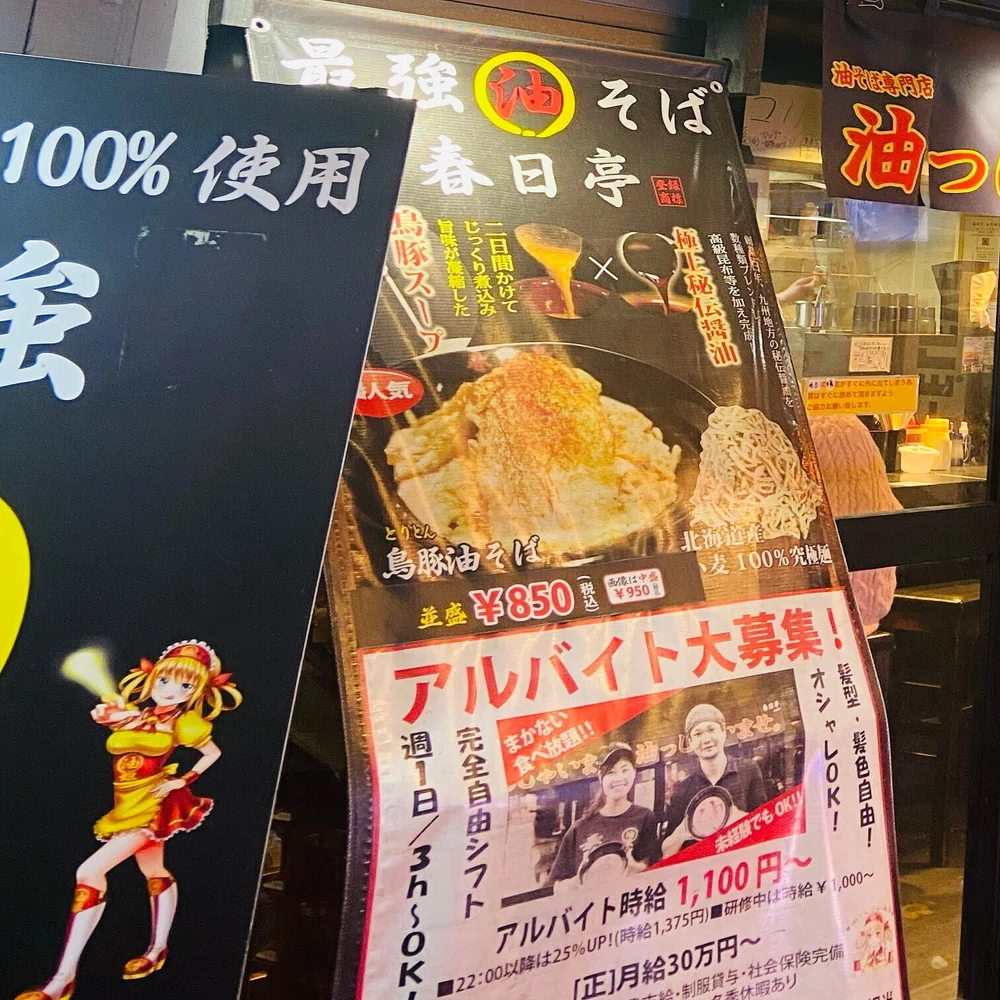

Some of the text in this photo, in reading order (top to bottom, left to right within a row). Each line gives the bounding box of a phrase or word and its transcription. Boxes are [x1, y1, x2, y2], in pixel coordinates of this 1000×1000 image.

[831, 61, 934, 99] 油そば専門店
[421, 135, 640, 208] 春日亭
[464, 220, 497, 317] じっくり煮込み
[485, 221, 518, 313] 二日間かけて
[382, 535, 542, 580] 鳥豚油そば
[385, 524, 436, 541] とりとん
[681, 523, 765, 552] 北海道産
[418, 601, 468, 629] 並盛
[469, 578, 577, 626] ¥850
[393, 608, 844, 725] アルバイト大募集!
[504, 712, 569, 755] まかない
[811, 667, 840, 832] オシャレOK!
[456, 727, 492, 919] 完全自由シフト
